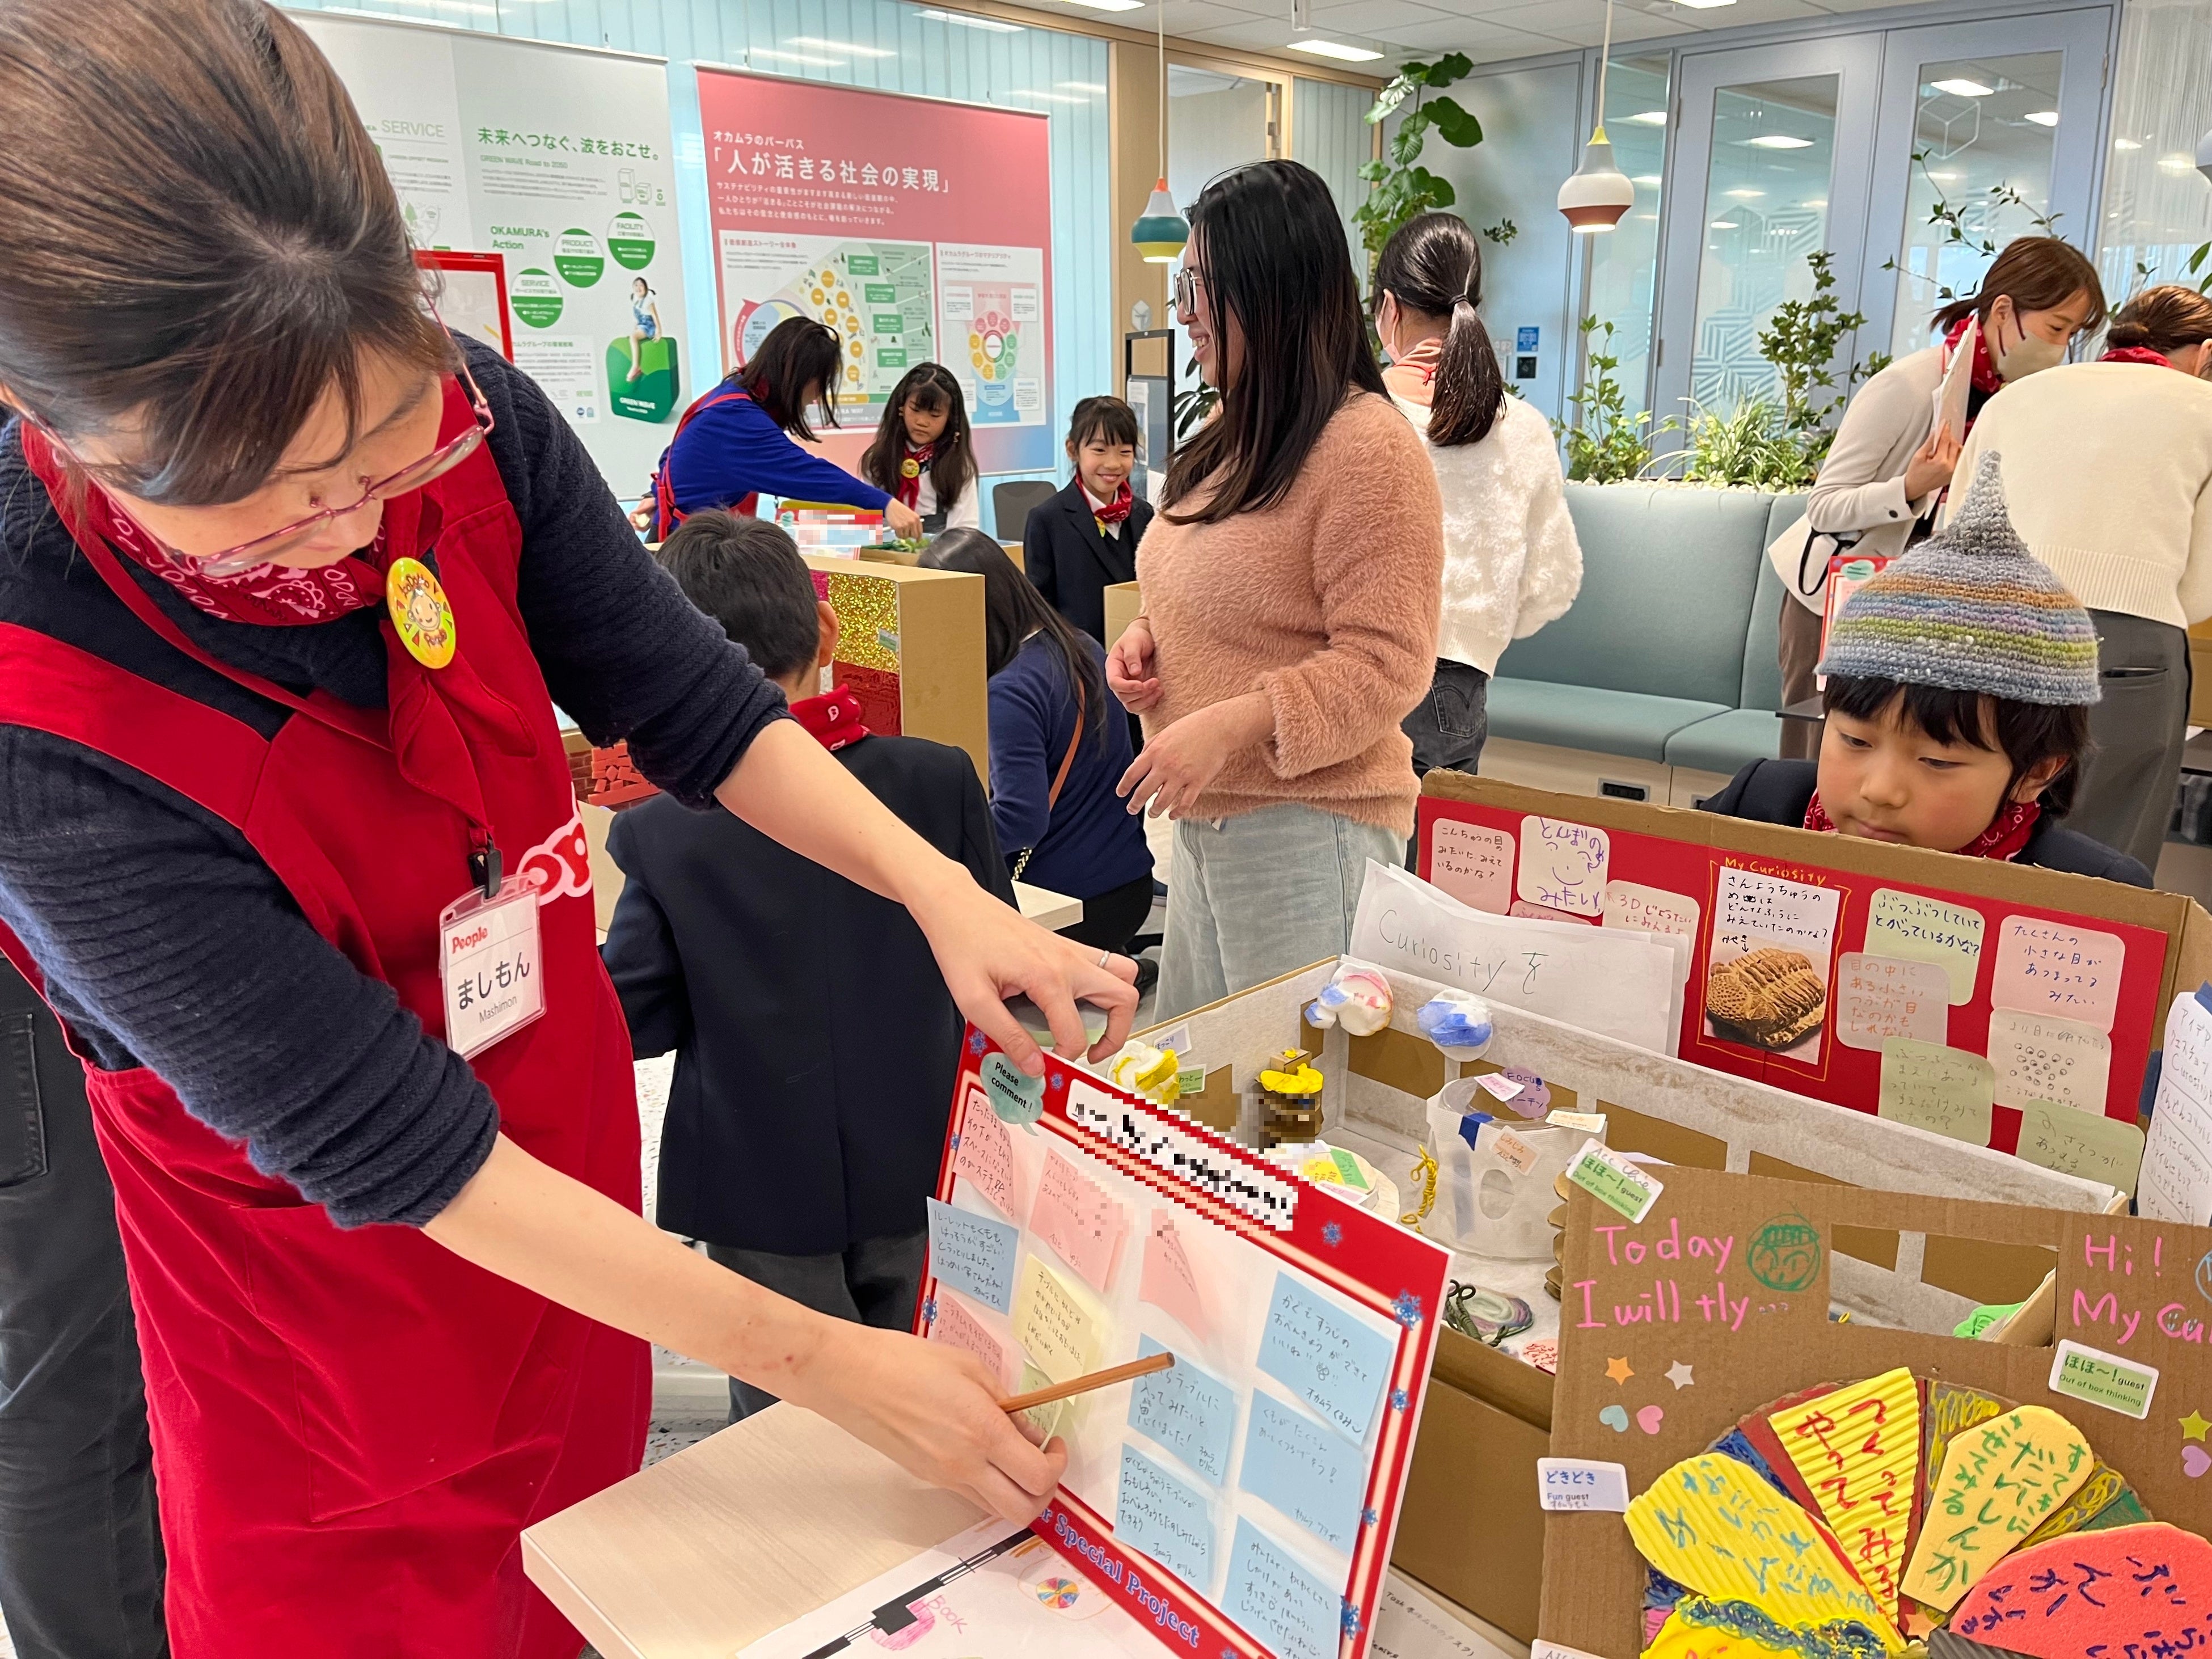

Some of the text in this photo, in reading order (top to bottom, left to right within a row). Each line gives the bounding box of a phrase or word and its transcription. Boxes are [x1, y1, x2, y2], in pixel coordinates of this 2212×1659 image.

[381, 120, 444, 137] SERVICE
[713, 130, 804, 150] オカムラのパーパス
[478, 128, 659, 161] 未来へつなぐ、波をおこせ。
[714, 146, 949, 194] 「人が活きる社会の実現」
[491, 226, 550, 238] OKAMURA's
[492, 239, 524, 250] Action
[1725, 857, 1827, 886] My Curiosity
[1728, 876, 1821, 901] さんようちゅうの
[1728, 902, 1799, 920] どんなふうに
[1878, 894, 1980, 930] ぶつぶつしていて
[452, 926, 488, 954] People
[1875, 914, 1980, 957] とがっているかな?
[2014, 925, 2079, 945] たくさんの
[1379, 910, 1506, 991] Curiosity
[2024, 945, 2103, 966] 小さな目が
[458, 952, 530, 1010] ましもん
[1851, 959, 1916, 977] 目の中に
[1850, 977, 1924, 997] ある小さい
[479, 996, 517, 1023] Mashimon
[1850, 997, 1916, 1014] つぶが目
[1852, 1007, 1910, 1027] なのかも
[995, 1062, 1019, 1086] Please
[991, 1077, 1027, 1109] comment
[1573, 1171, 1585, 1181] Out
[1594, 1184, 1606, 1196] box
[1607, 1194, 1635, 1216] thinking
[1621, 1187, 1643, 1203] guest
[1594, 1218, 1734, 1274] Today
[2086, 1234, 2133, 1276] Hi
[1573, 1280, 1607, 1328] I
[1615, 1280, 1680, 1326] will
[2073, 1289, 2212, 1345] My Cu
[2059, 1374, 2075, 1383] Out
[2089, 1383, 2104, 1393] box
[2106, 1390, 2142, 1407] thinking
[2118, 1378, 2144, 1390] guest
[1547, 1471, 1595, 1485] どきどき
[1056, 1513, 1200, 1648] Special Project
